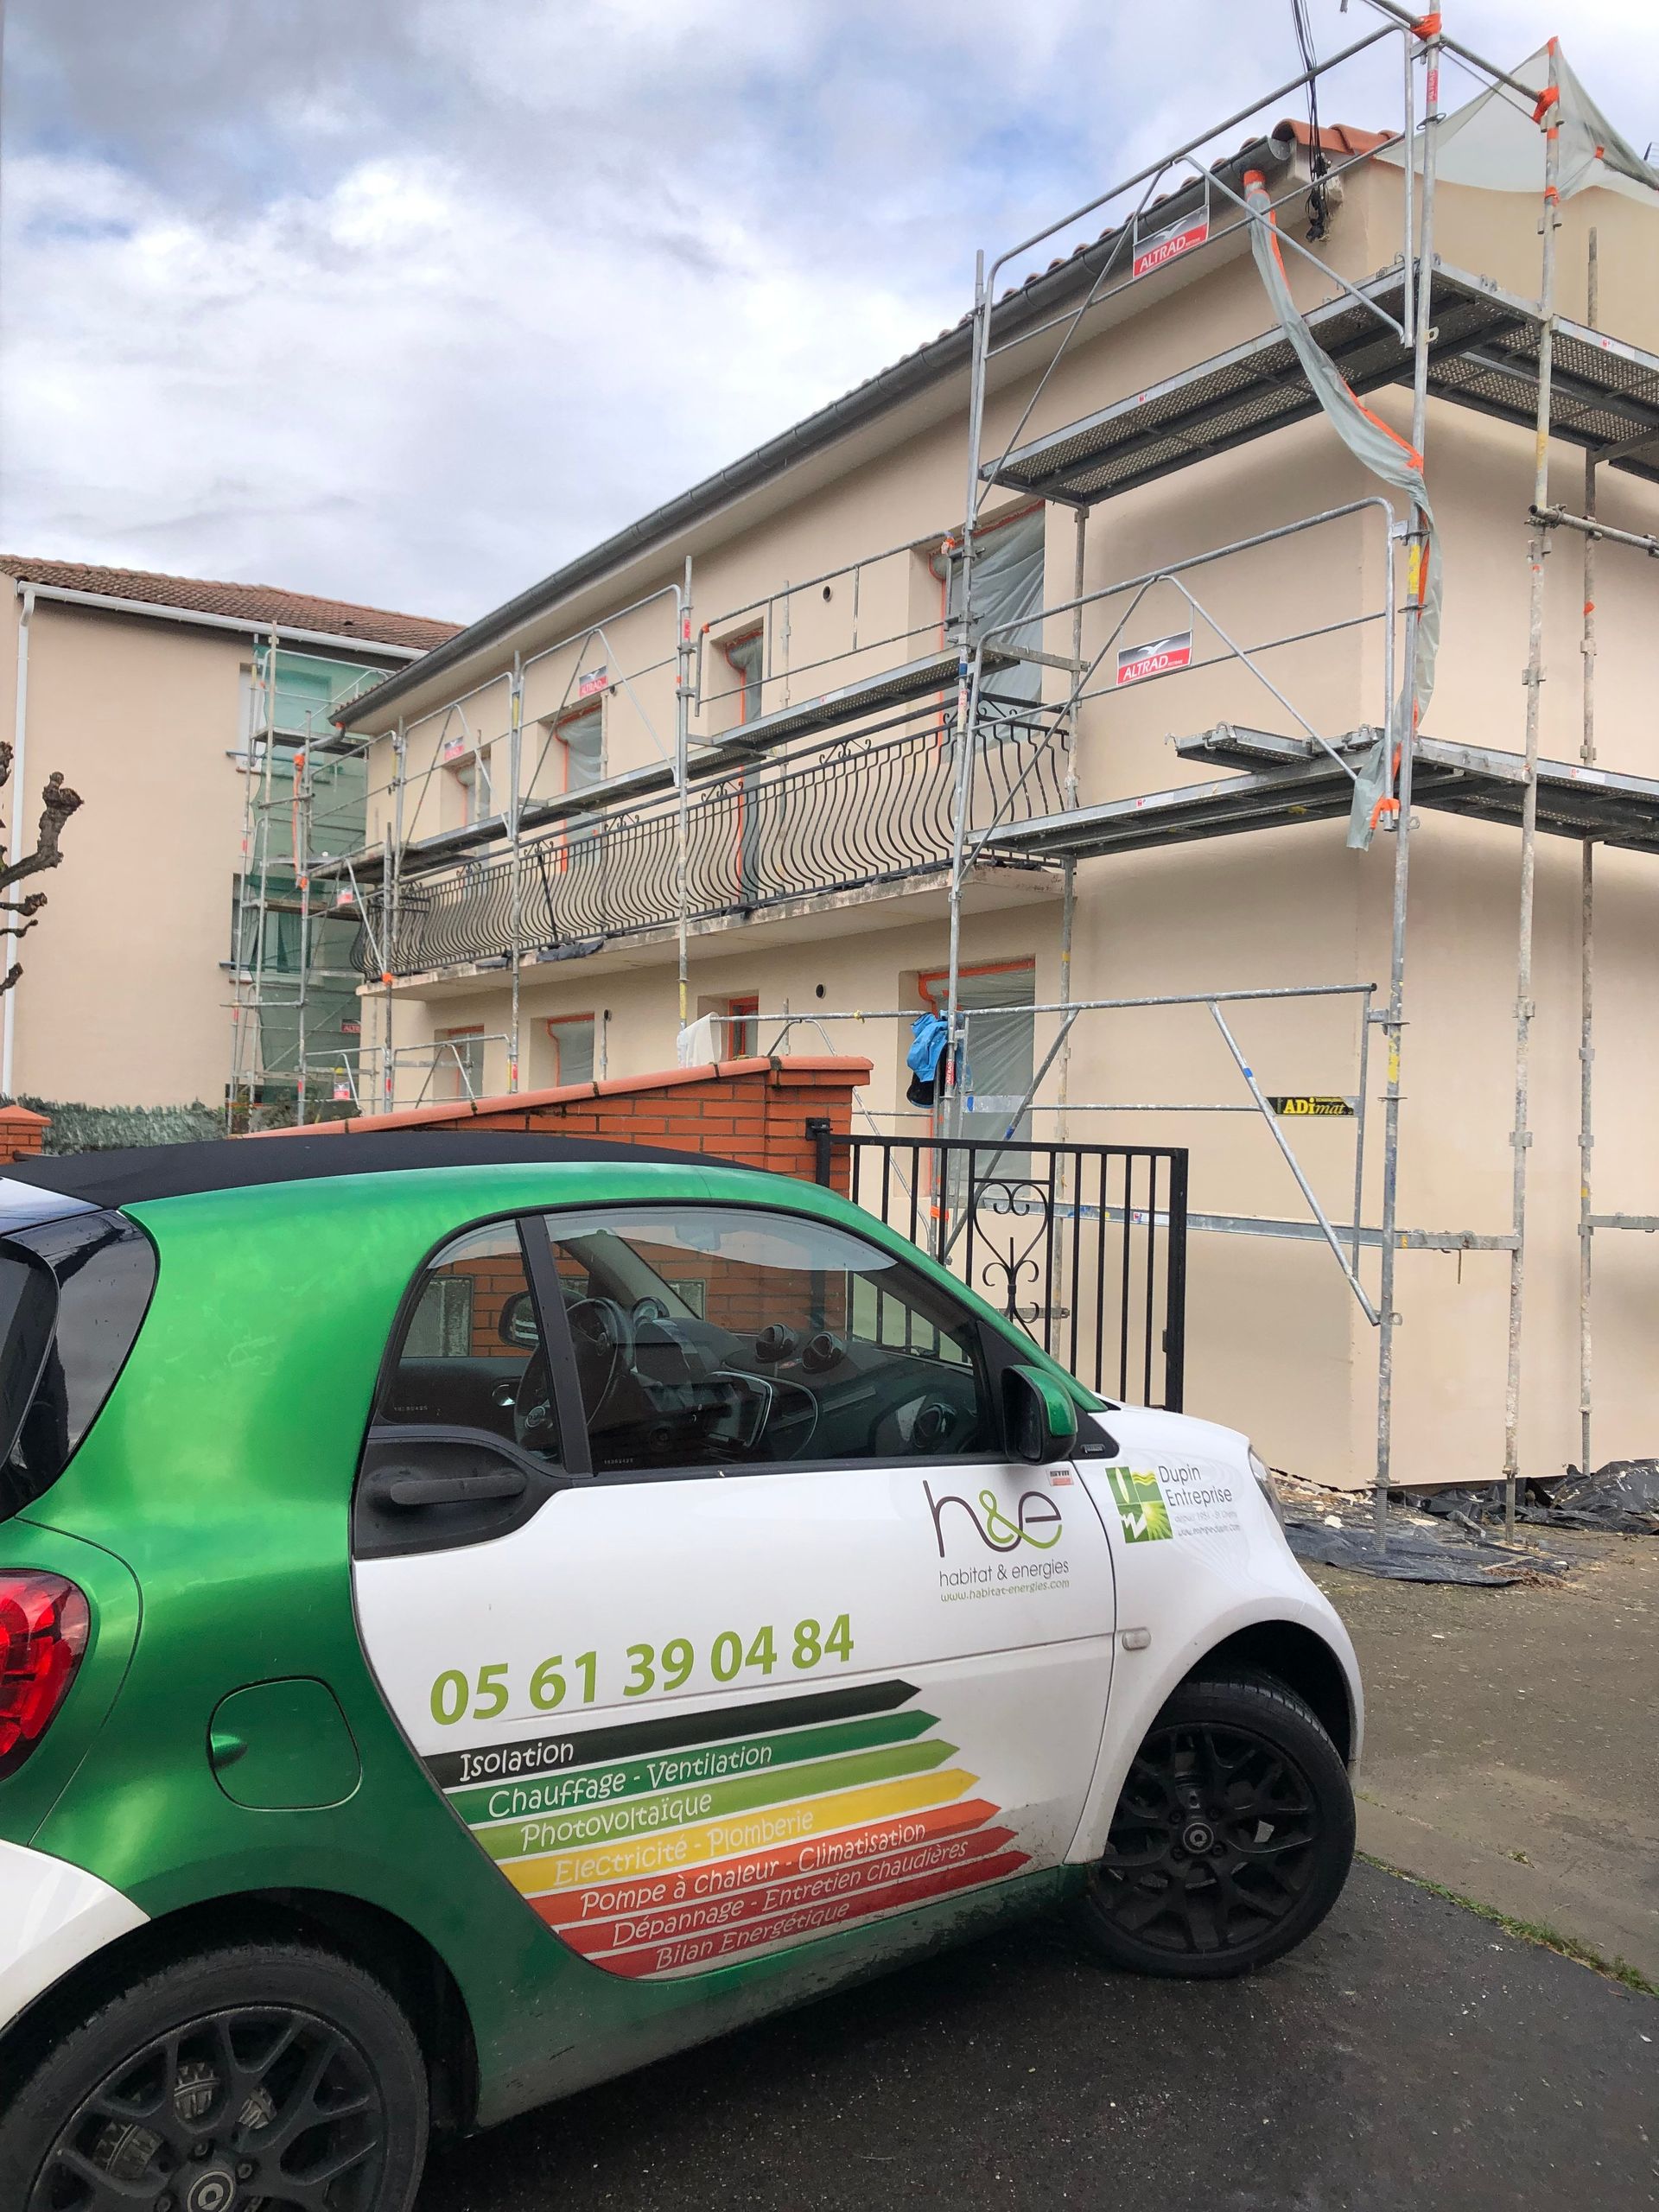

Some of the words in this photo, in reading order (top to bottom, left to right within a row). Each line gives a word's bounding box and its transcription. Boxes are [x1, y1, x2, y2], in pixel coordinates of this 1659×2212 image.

[1139, 236, 1186, 272] ALTRAD
[1122, 655, 1168, 681] ALTRAD
[1158, 1464, 1201, 1485] Dupin
[1165, 1485, 1233, 1507] Entreprise
[939, 1565, 993, 1587] habitat
[996, 1564, 1007, 1581] &
[1012, 1559, 1070, 1580] energies
[940, 1579, 1071, 1603] www.habitat-energies.com
[430, 1662, 509, 1726] 05
[529, 1651, 596, 1711] 61
[622, 1637, 695, 1697] 39
[710, 1625, 778, 1682] 04
[791, 1613, 855, 1669] 84
[460, 1742, 574, 1782] Isolation
[488, 1773, 626, 1818] Chauffage
[646, 1745, 772, 1789] Ventilation
[520, 1793, 712, 1853] Photovoltaïque
[553, 1834, 688, 1887] Electricité
[707, 1810, 814, 1857] Plomberie
[581, 1883, 666, 1917] Pompe
[673, 1874, 686, 1900] à
[694, 1860, 779, 1894] chaleur
[798, 1823, 926, 1873] Climatisation
[613, 1898, 745, 1948] Dépannage
[761, 1869, 861, 1912] Entretien
[867, 1841, 969, 1883] chaudières
[656, 1938, 714, 1971] Bilan
[718, 1903, 850, 1955] Energétique
